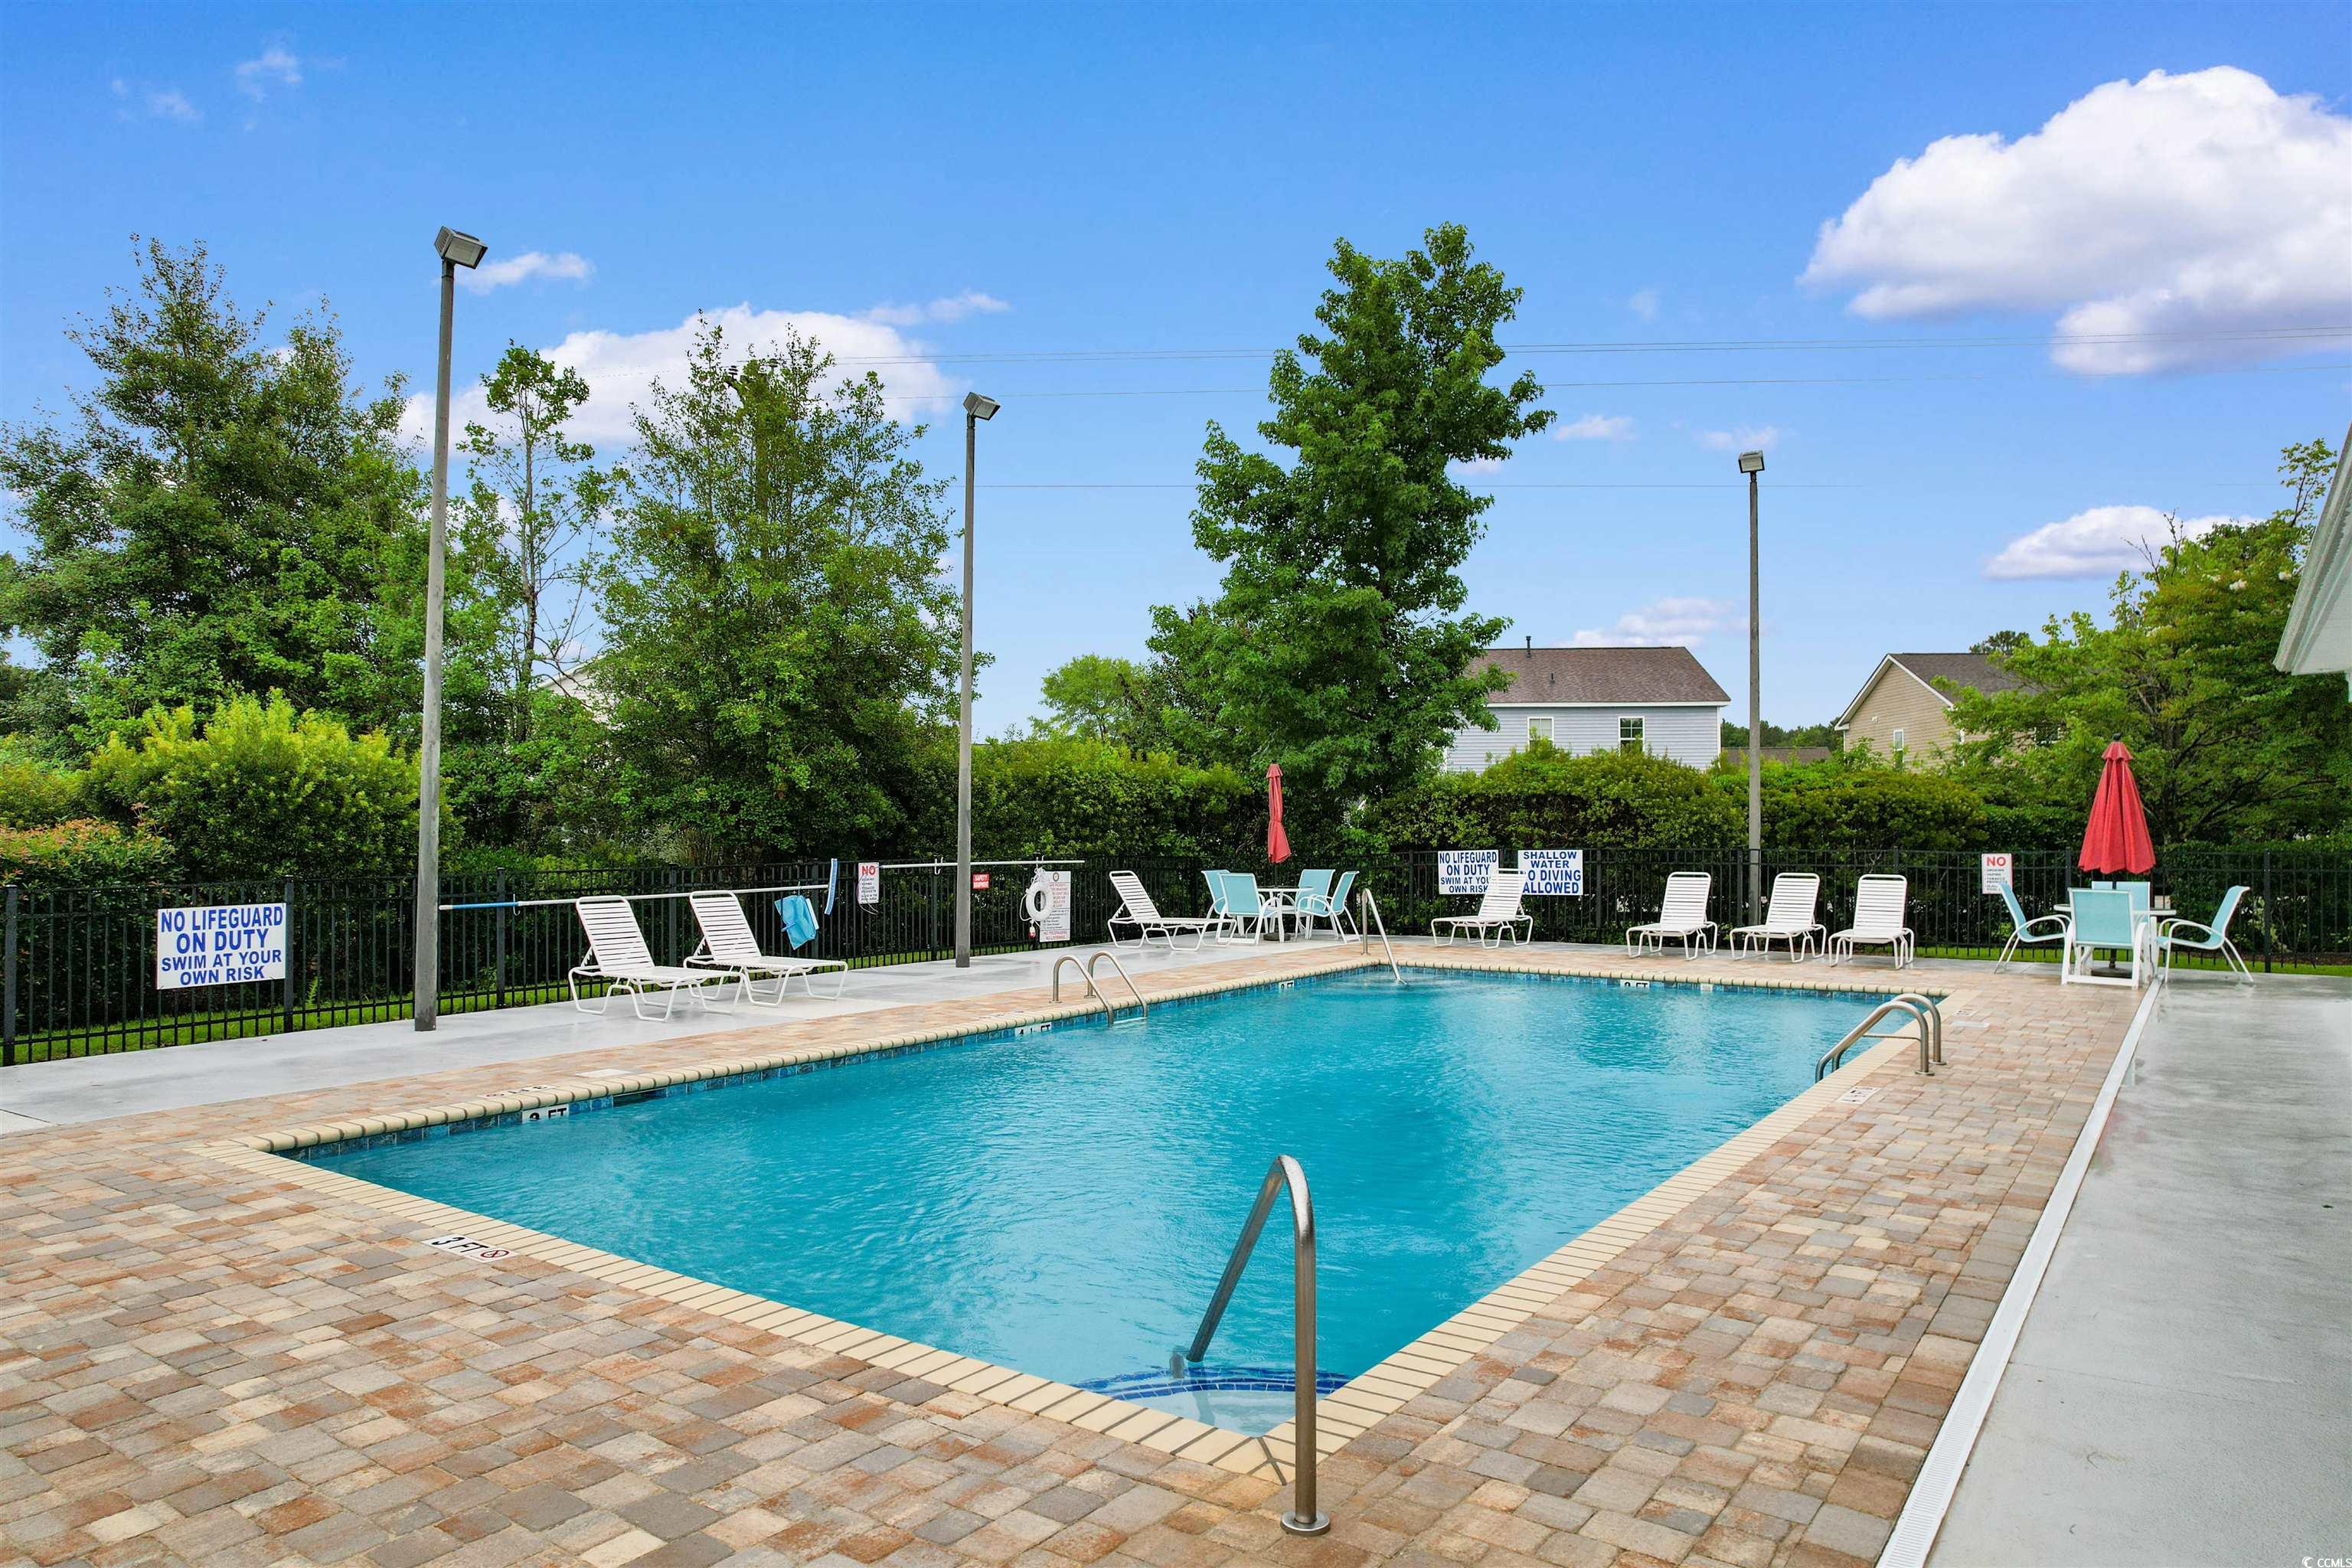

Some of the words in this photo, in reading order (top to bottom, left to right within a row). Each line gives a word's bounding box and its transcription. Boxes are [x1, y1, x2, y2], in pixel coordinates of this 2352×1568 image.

[1439, 852, 1450, 864] NO
[1453, 851, 1497, 864] LIFEGUARD
[1524, 851, 1577, 860] SHALLOW
[1530, 860, 1570, 868] WATER
[1986, 857, 2006, 866] NO
[862, 865, 875, 875] NO
[1446, 864, 1460, 876] ON
[1464, 864, 1490, 875] DUTY
[1540, 870, 1581, 881] DIVING
[1440, 877, 1461, 885] SWIM
[1523, 882, 1579, 893] ALLOWED
[161, 911, 185, 933] NO
[192, 906, 283, 931] LIFEGUARD
[176, 932, 206, 954] ON
[214, 929, 269, 952] DUTY
[162, 955, 206, 972] SWIM
[213, 953, 233, 968] AT
[239, 949, 282, 965] YOUR
[180, 969, 219, 985] OWN
[227, 965, 265, 982] RISK
[431, 1236, 466, 1246] 3
[448, 1242, 489, 1253] FT
